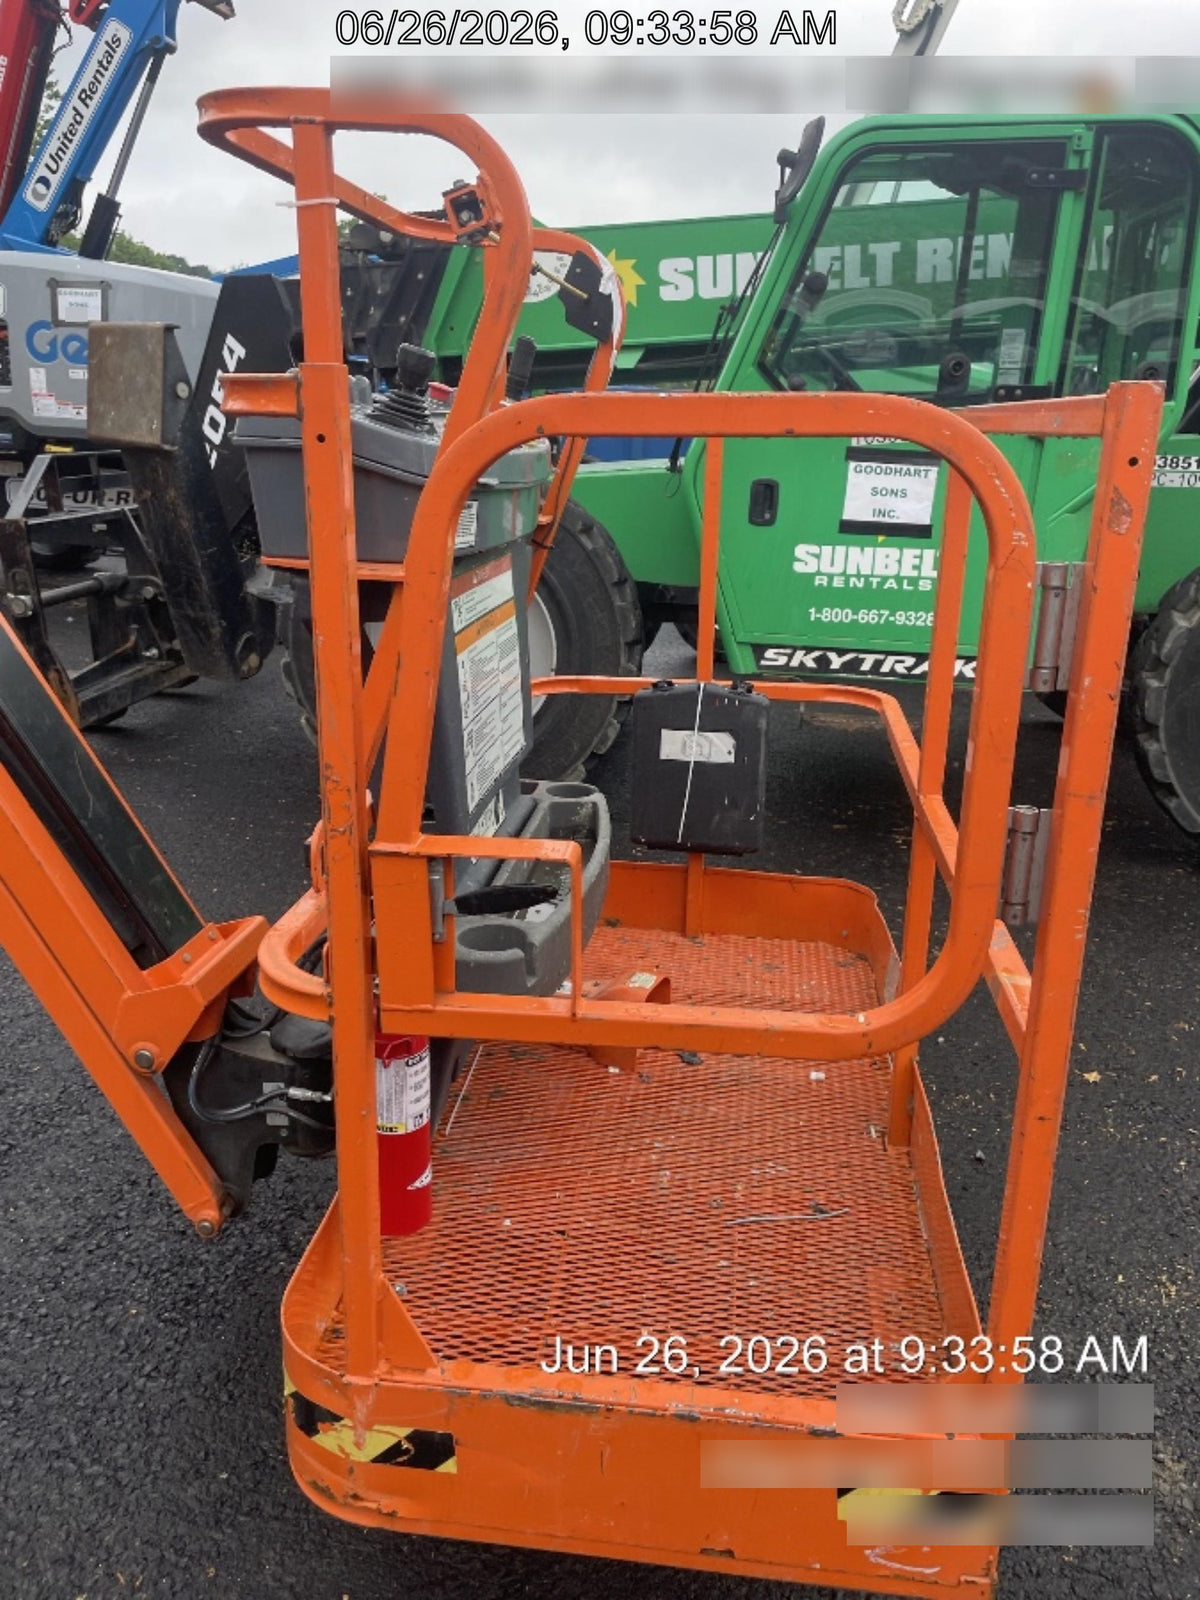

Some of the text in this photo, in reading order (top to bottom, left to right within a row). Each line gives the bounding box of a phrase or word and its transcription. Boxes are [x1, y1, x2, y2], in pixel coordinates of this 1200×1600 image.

[45, 33, 122, 175] United Rentals
[658, 241, 901, 301] SUNELT
[853, 464, 932, 479] GOODHART
[870, 487, 908, 498] SONS
[872, 508, 900, 519] INC.
[793, 544, 939, 578] SUNBEL
[814, 576, 932, 591] RENTALS
